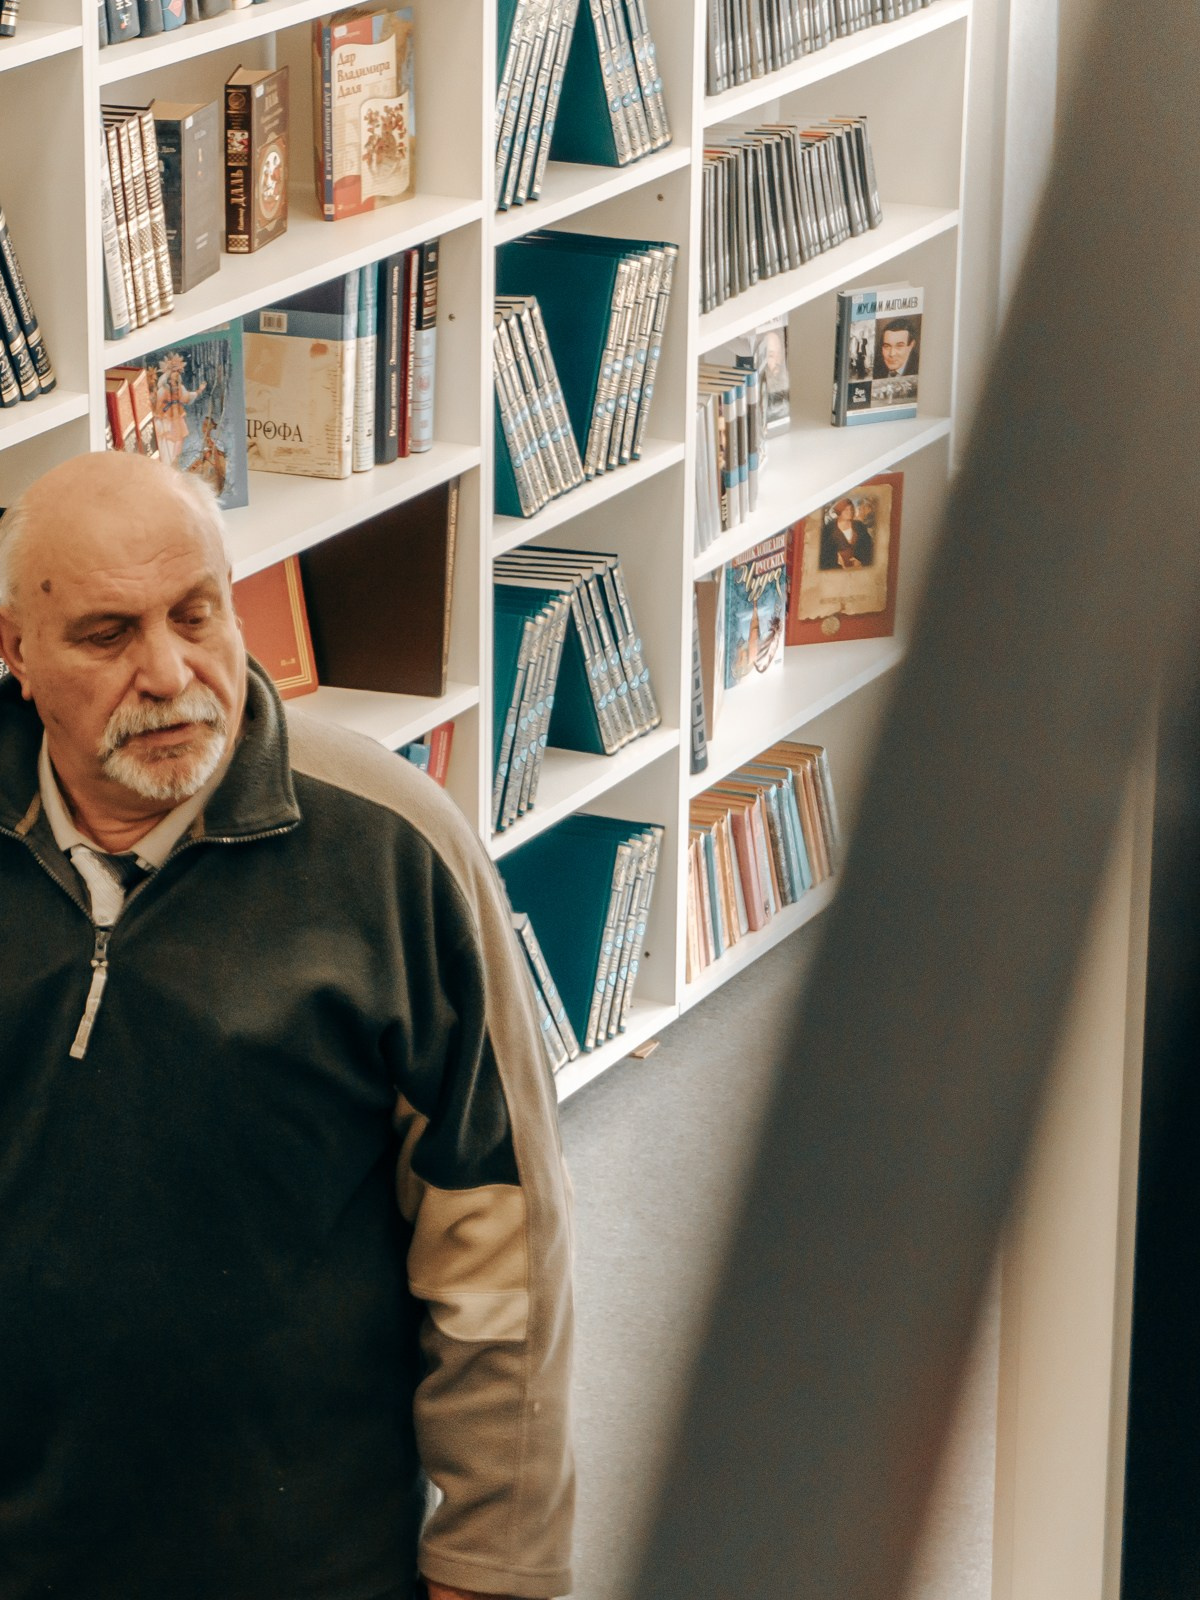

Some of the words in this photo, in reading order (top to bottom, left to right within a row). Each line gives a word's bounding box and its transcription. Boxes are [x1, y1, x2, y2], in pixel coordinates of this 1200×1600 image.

[337, 51, 355, 66] Дар
[338, 62, 391, 82] Владимира
[337, 83, 361, 98] Даля
[231, 169, 245, 206] ДАЛЬ
[856, 301, 883, 315] МУСЛИМ
[885, 297, 919, 311] МАГОМАЕВ
